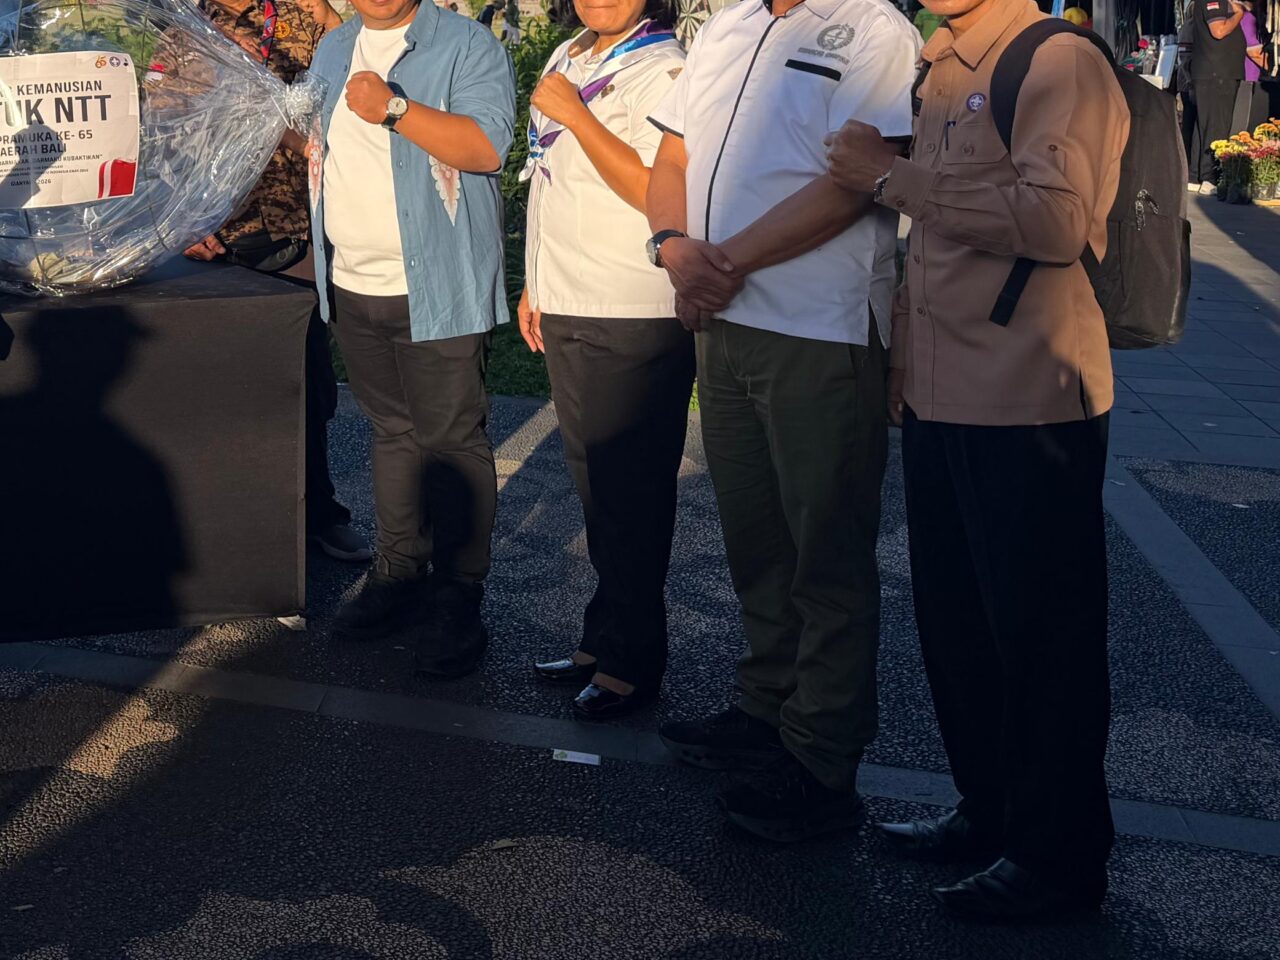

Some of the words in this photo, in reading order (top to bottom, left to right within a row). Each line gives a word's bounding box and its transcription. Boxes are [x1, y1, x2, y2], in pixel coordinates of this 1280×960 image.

[17, 80, 102, 96] KEMANUSIAN
[55, 94, 112, 124] NTT
[78, 129, 93, 140] 65
[41, 142, 67, 154] BALI
[10, 179, 34, 187] GIANYA
